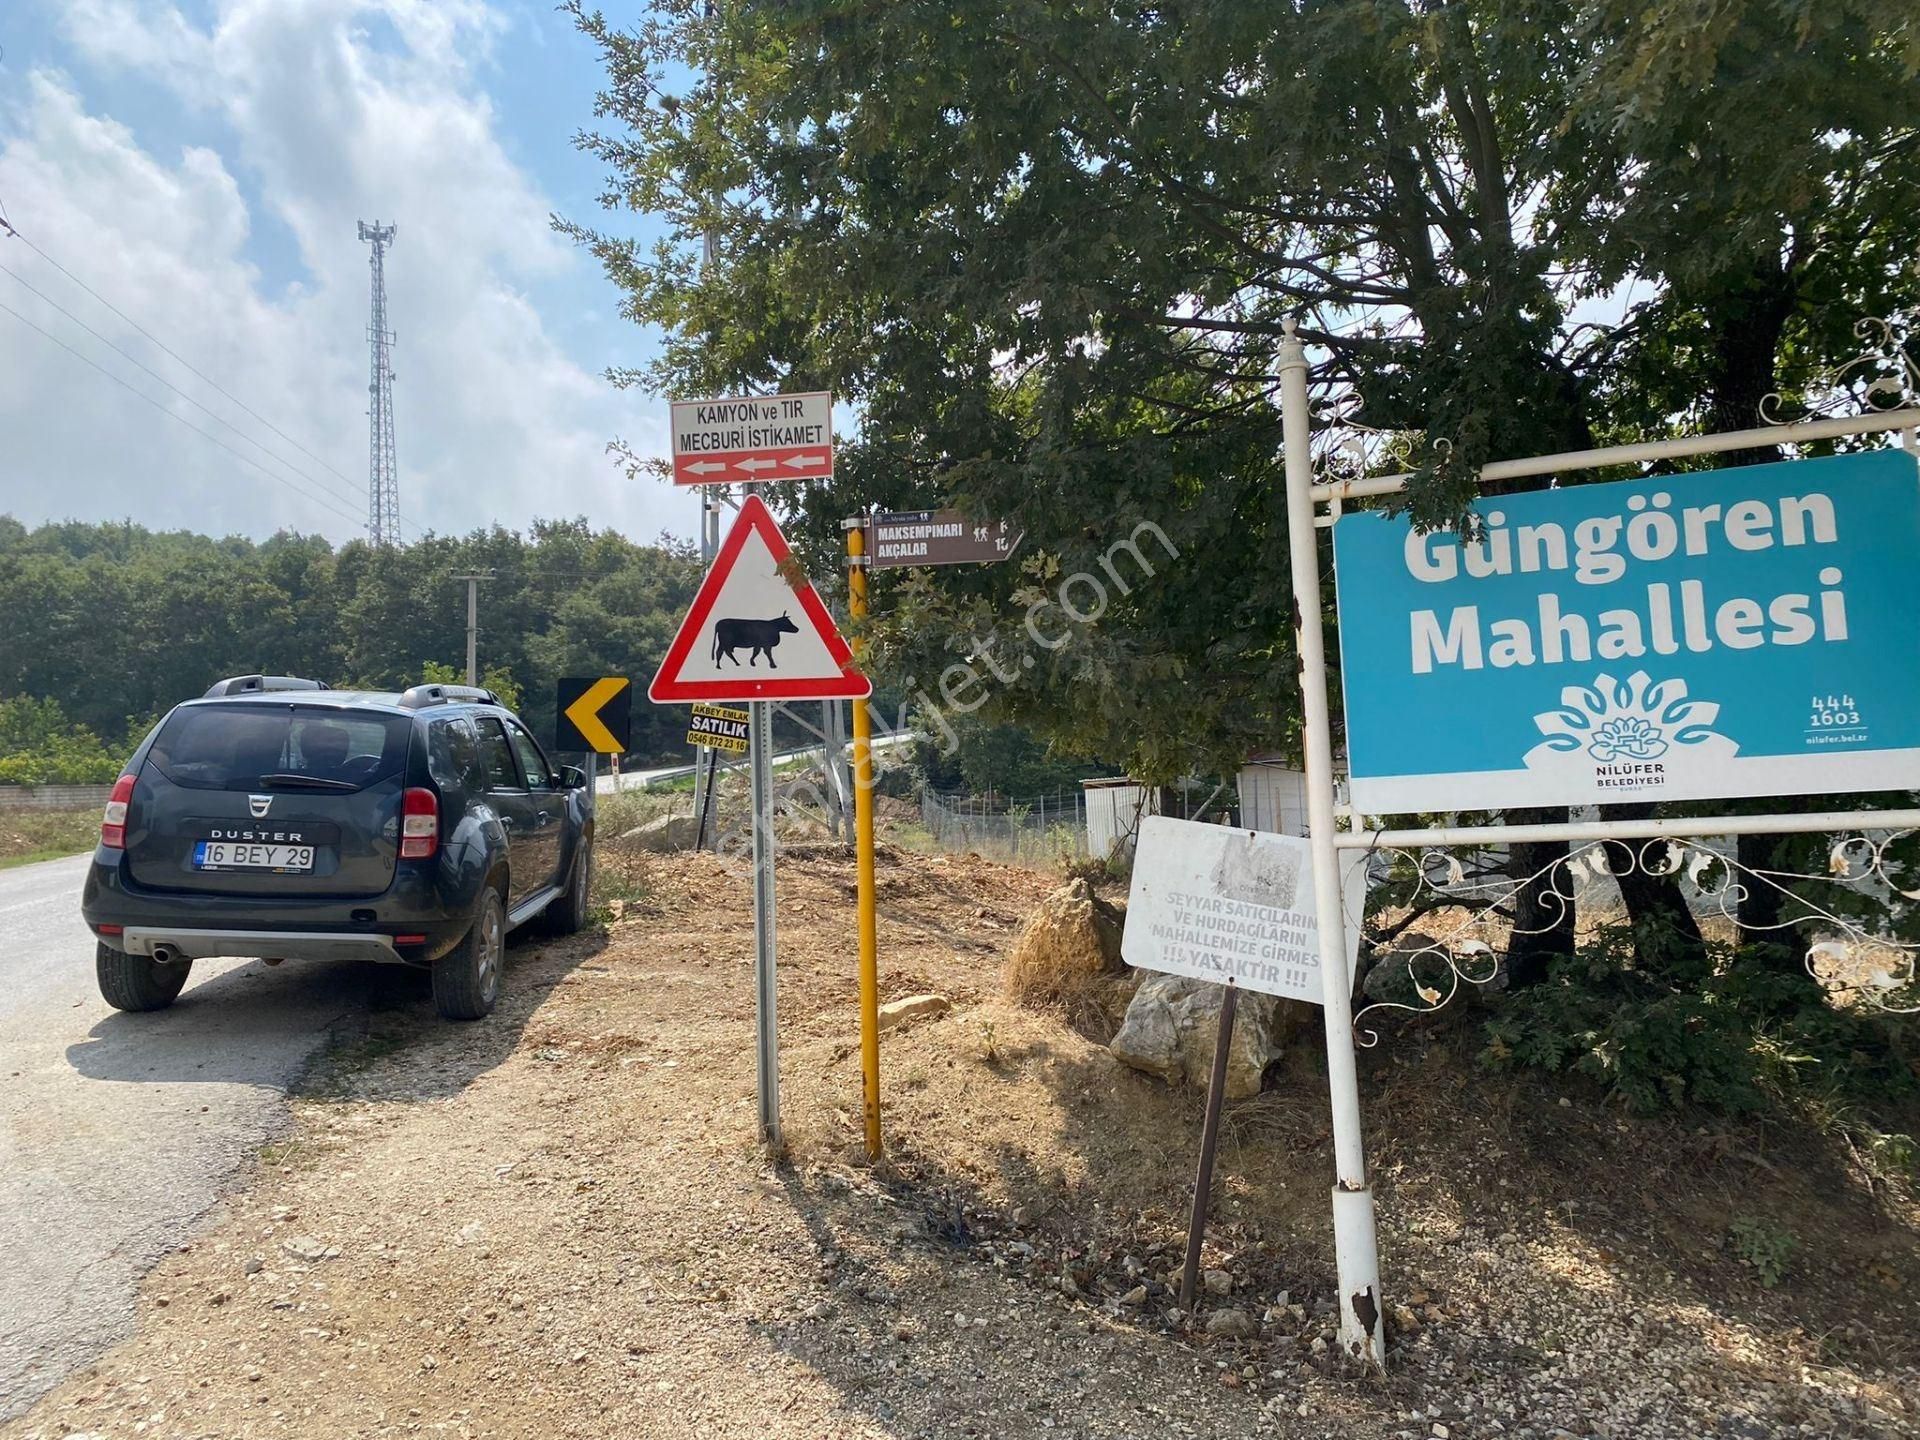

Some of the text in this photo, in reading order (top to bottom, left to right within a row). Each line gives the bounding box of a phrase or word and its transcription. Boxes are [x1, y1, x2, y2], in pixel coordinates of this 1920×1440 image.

[696, 400, 804, 425] KAMYON ve TIR
[680, 424, 823, 451] MECBURİ İSTİKAMET
[878, 523, 963, 541] MAKSEMPINARI
[1404, 492, 1838, 584] Güngören
[878, 542, 928, 559] AKÇALAR
[1410, 566, 1849, 674] Mahallesi
[1812, 694, 1855, 712] 444
[694, 705, 749, 721] AKBEY EMLAK
[1810, 709, 1861, 727] 1603
[691, 715, 746, 737] SATILIK
[688, 733, 745, 751] 0546 872 23 16
[1596, 763, 1665, 776] NİLÜFER
[1597, 775, 1664, 787] BELEDİYESİ
[211, 829, 302, 842] DUSTER
[206, 844, 311, 866] 16 BEY 29
[1167, 892, 1318, 930] SEYYAR SATICILARIN
[1174, 909, 1192, 925] VE
[1151, 924, 1321, 969] MAHALLEMİZE GİRMES
[1189, 950, 1280, 984] YASAKTIR
[1286, 968, 1308, 989] !!!
